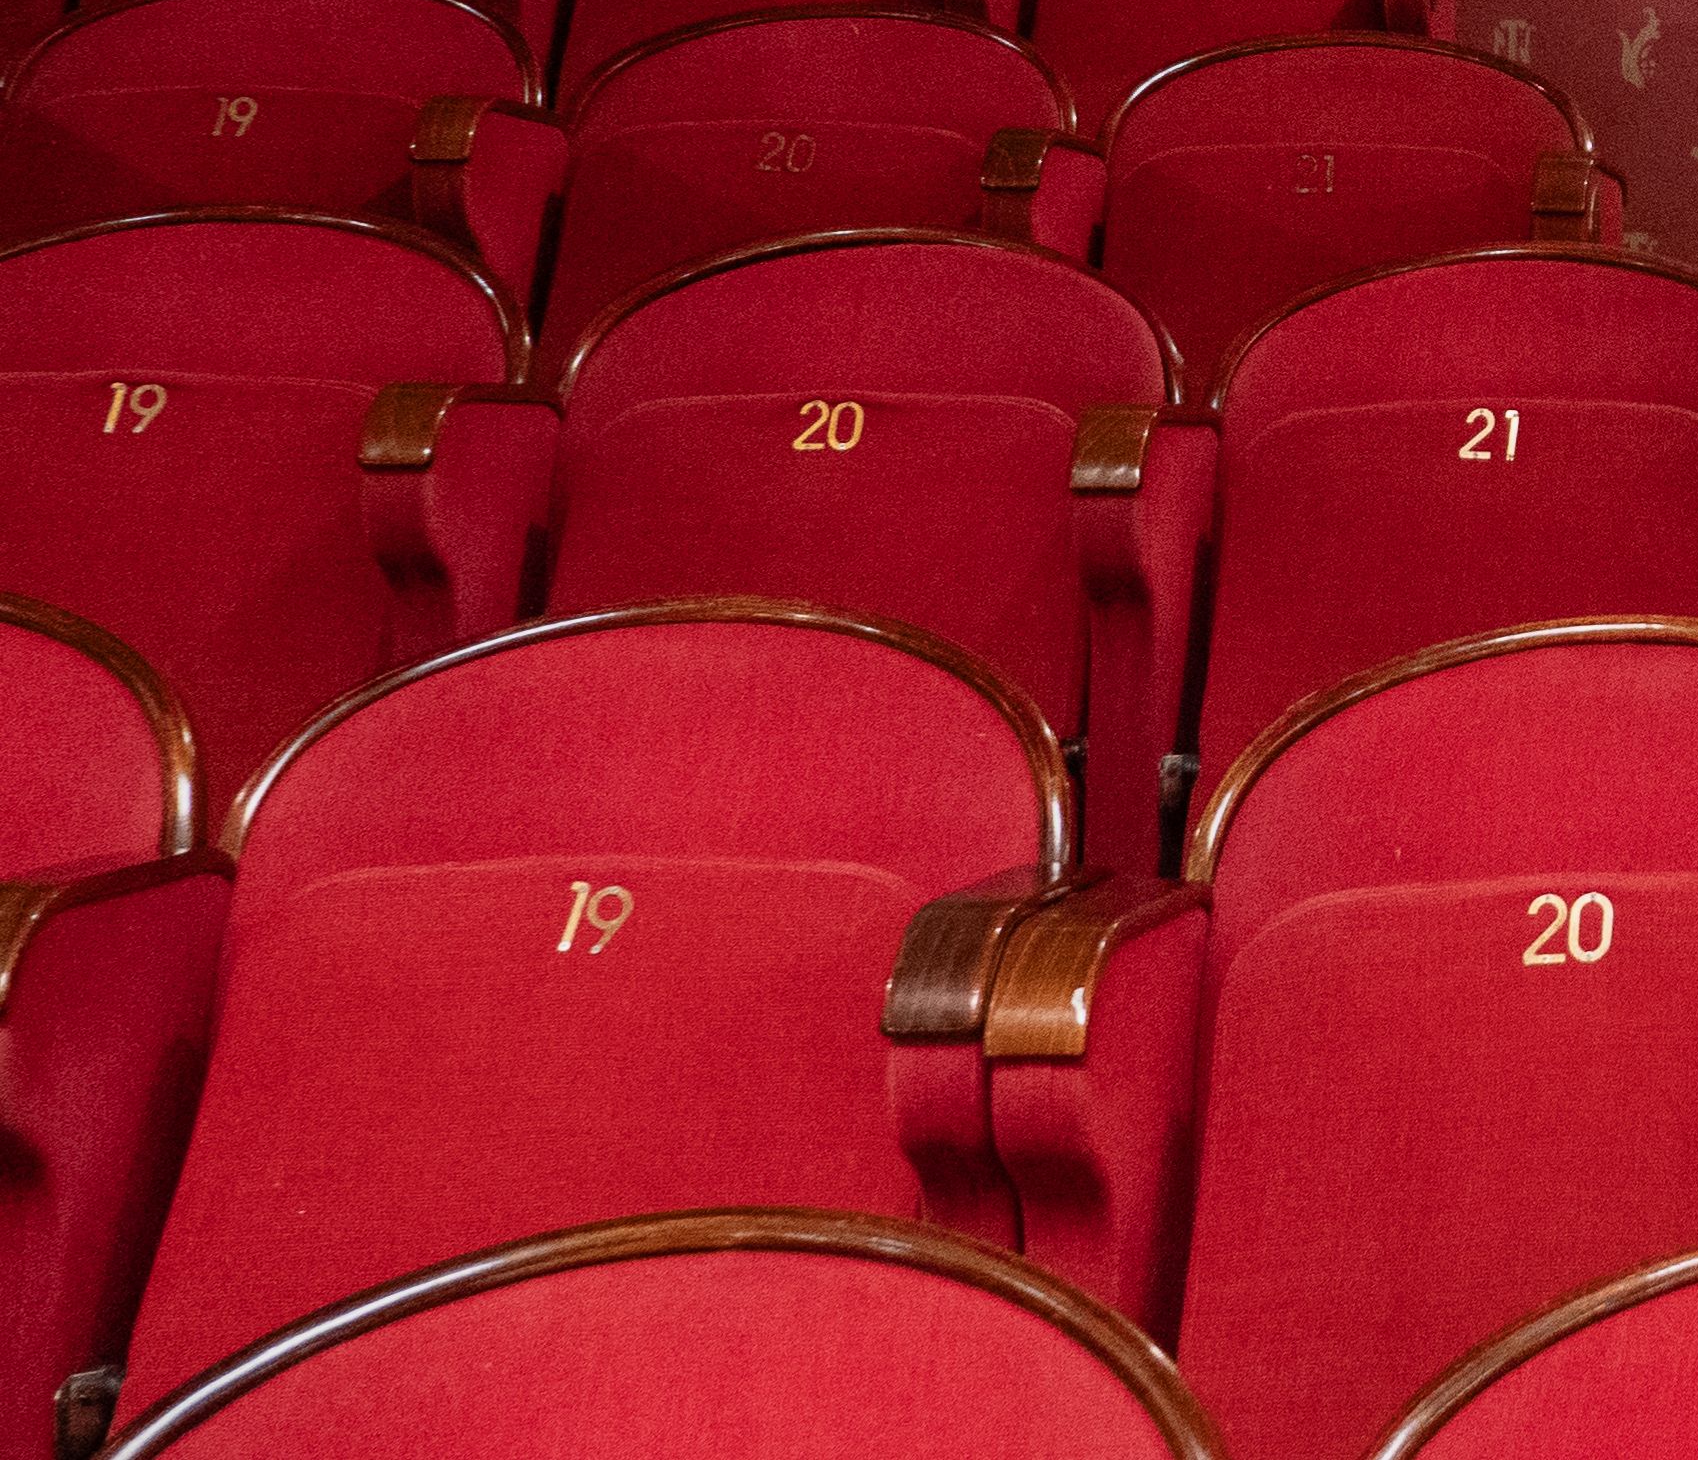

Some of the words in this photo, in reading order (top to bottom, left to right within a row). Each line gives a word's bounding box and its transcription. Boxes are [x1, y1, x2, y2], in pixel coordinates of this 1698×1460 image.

[211, 96, 259, 138] 19
[754, 131, 817, 173] 20
[1293, 153, 1335, 194] 21
[102, 381, 168, 434] 19
[791, 399, 865, 451] 20
[1458, 407, 1520, 461] 21
[555, 881, 635, 955] 19
[1521, 892, 1615, 966] 20
